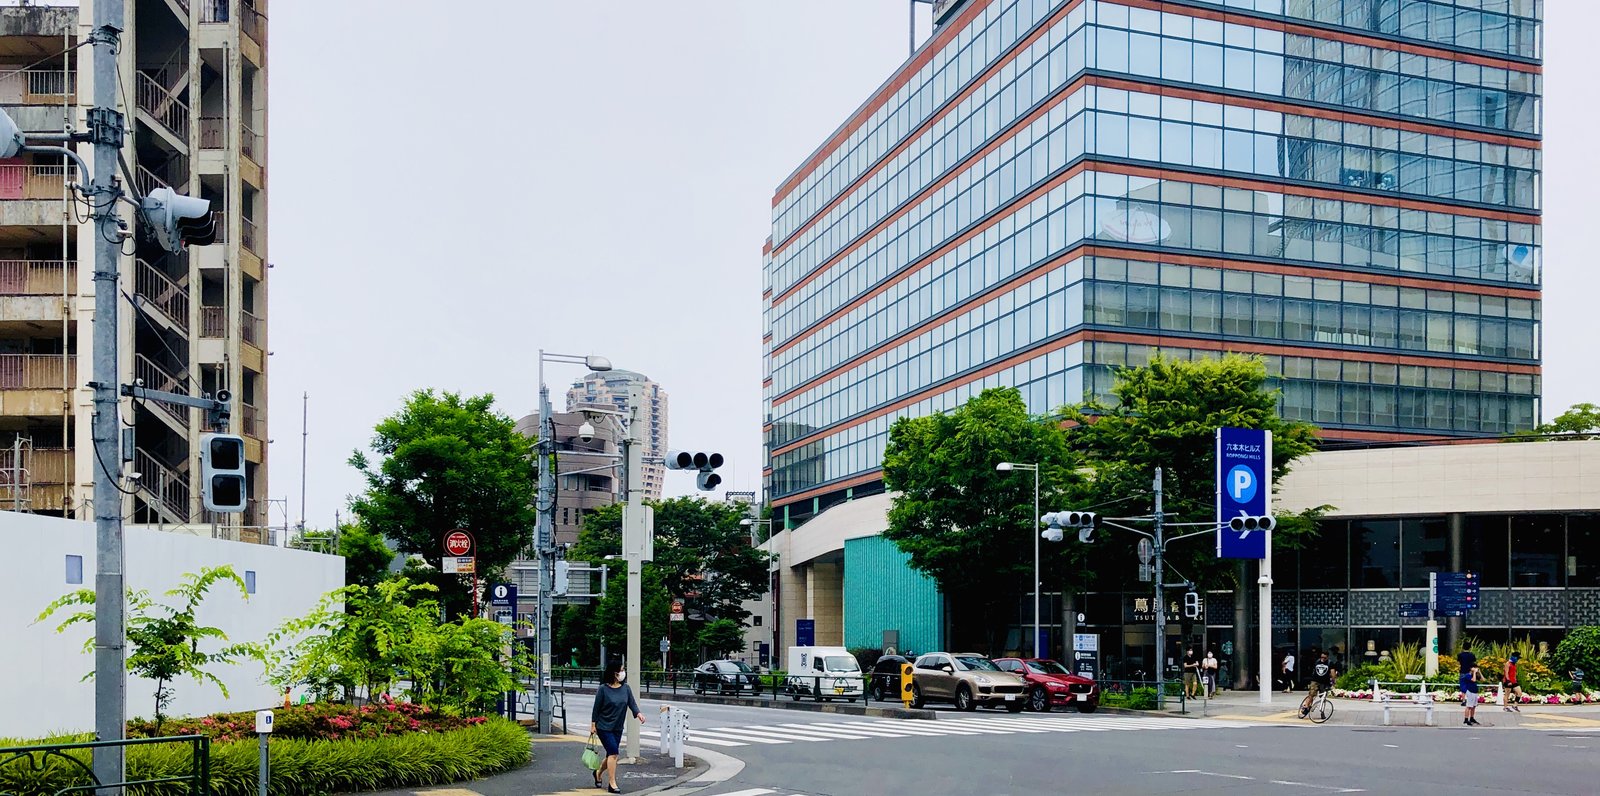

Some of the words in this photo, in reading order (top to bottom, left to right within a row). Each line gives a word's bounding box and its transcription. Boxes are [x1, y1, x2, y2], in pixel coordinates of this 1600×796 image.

[1226, 443, 1261, 453] 六本木ヒルズ
[1234, 470, 1252, 498] P
[450, 539, 468, 549] 消火栓
